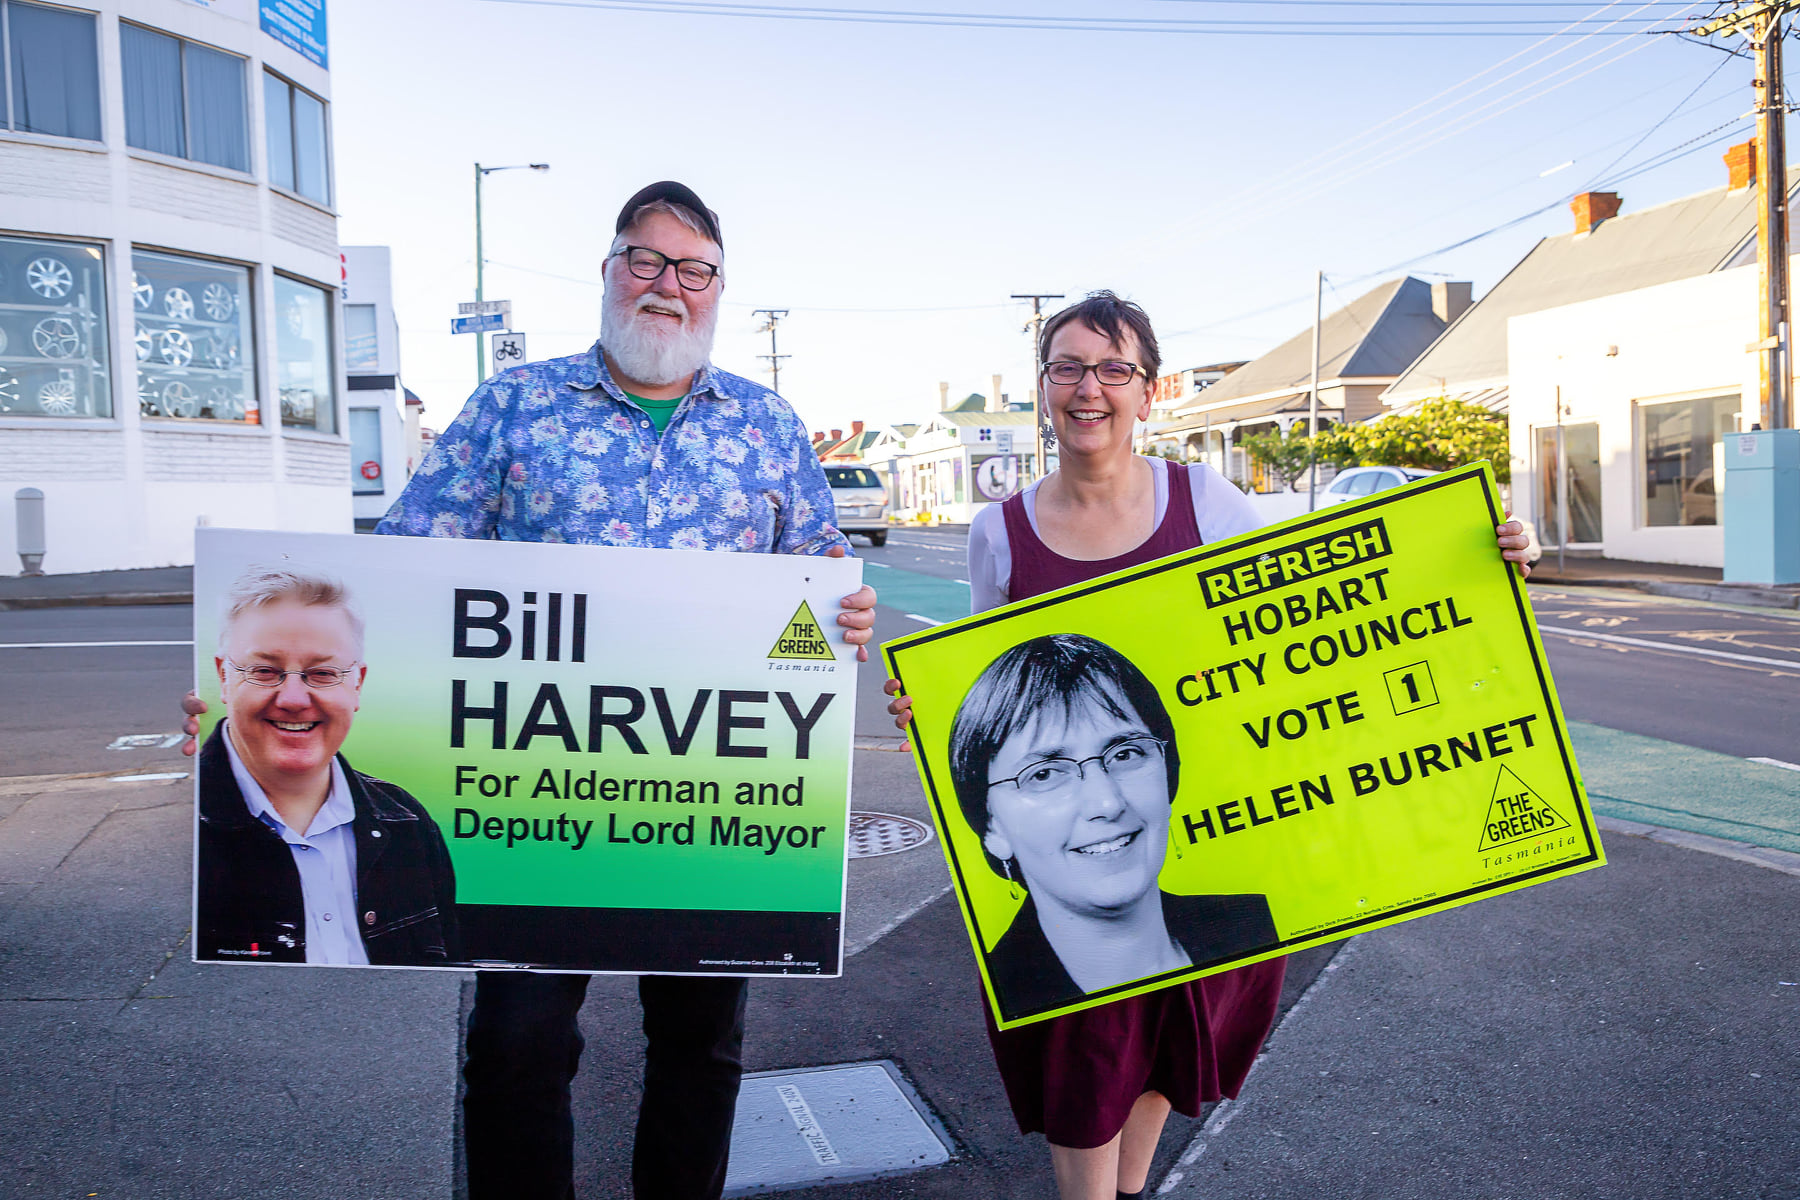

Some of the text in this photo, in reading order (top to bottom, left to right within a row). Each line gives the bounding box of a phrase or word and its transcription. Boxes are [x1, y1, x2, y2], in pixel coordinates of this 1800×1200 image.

[1205, 526, 1385, 603] REFRESH
[452, 588, 588, 663] Bill
[1222, 567, 1390, 646] HOBART
[779, 639, 825, 655] GREENS
[792, 623, 814, 638] THE
[768, 662, 835, 672] Tasmania
[1176, 597, 1473, 707] CITY COUNCIL
[450, 679, 837, 760] HARVEY
[1242, 672, 1421, 749] VOTE 1
[455, 765, 804, 807] For Alderman and
[1182, 714, 1538, 844] HELEN BURNET
[1487, 808, 1555, 842] GREENS
[1496, 792, 1533, 818] THE
[453, 808, 826, 855] Deputy Lord Mayor
[1482, 836, 1575, 868] Tasmania
[792, 1105, 817, 1131] SIGNAL
[806, 1132, 836, 1163] TRAFFIC
